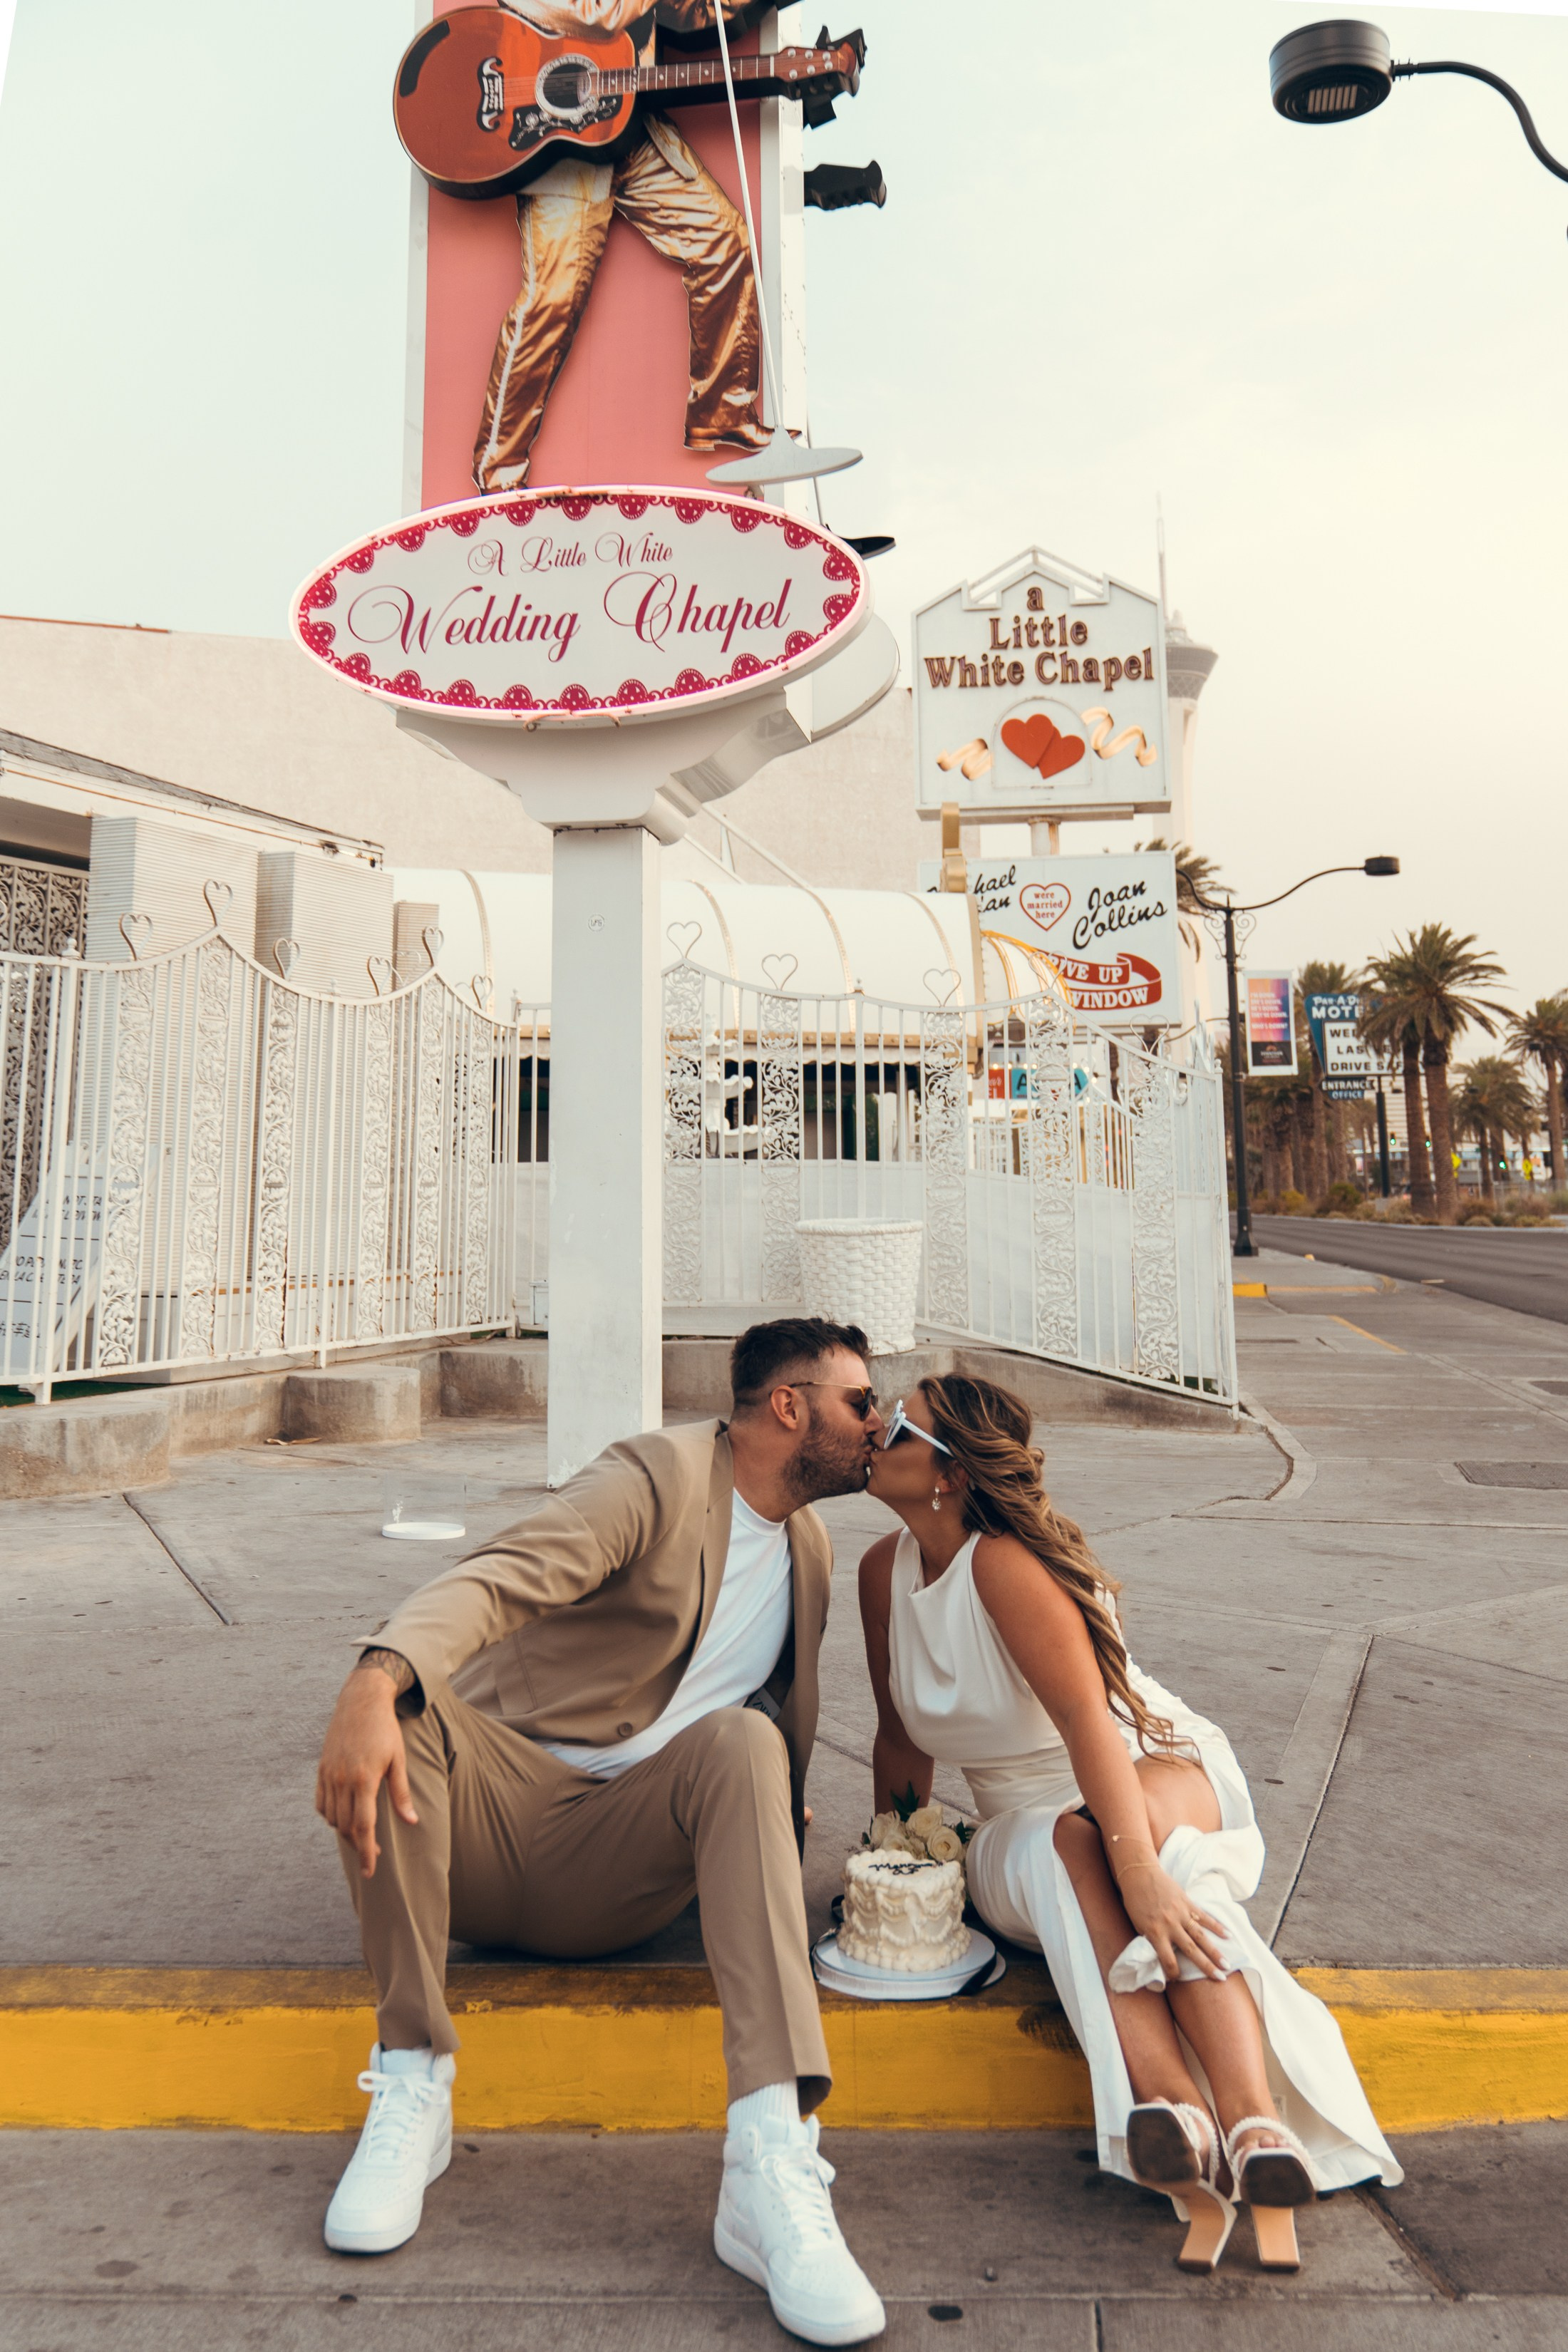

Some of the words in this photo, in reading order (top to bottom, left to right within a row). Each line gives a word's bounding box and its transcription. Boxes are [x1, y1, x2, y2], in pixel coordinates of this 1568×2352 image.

[468, 539, 509, 576] A
[520, 536, 586, 574] Little
[594, 531, 673, 567] White
[1027, 587, 1045, 611] a
[347, 584, 581, 663] Wedding
[603, 571, 793, 653] Chapel
[989, 614, 1088, 649] Little
[924, 654, 1025, 688] White
[1035, 647, 1155, 691] Chapel
[1033, 892, 1055, 900] were
[1087, 880, 1147, 922] Joan
[1027, 900, 1063, 909] married
[1036, 910, 1055, 919] here
[1072, 901, 1168, 950] Collins
[1098, 966, 1123, 984] UP
[1311, 1006, 1365, 1019] MOTE
[1336, 1046, 1364, 1055] LAS
[1331, 1062, 1371, 1071] DRIVE
[1322, 1080, 1372, 1090] ENTRANCE
[1331, 1090, 1363, 1099] OFFICE
